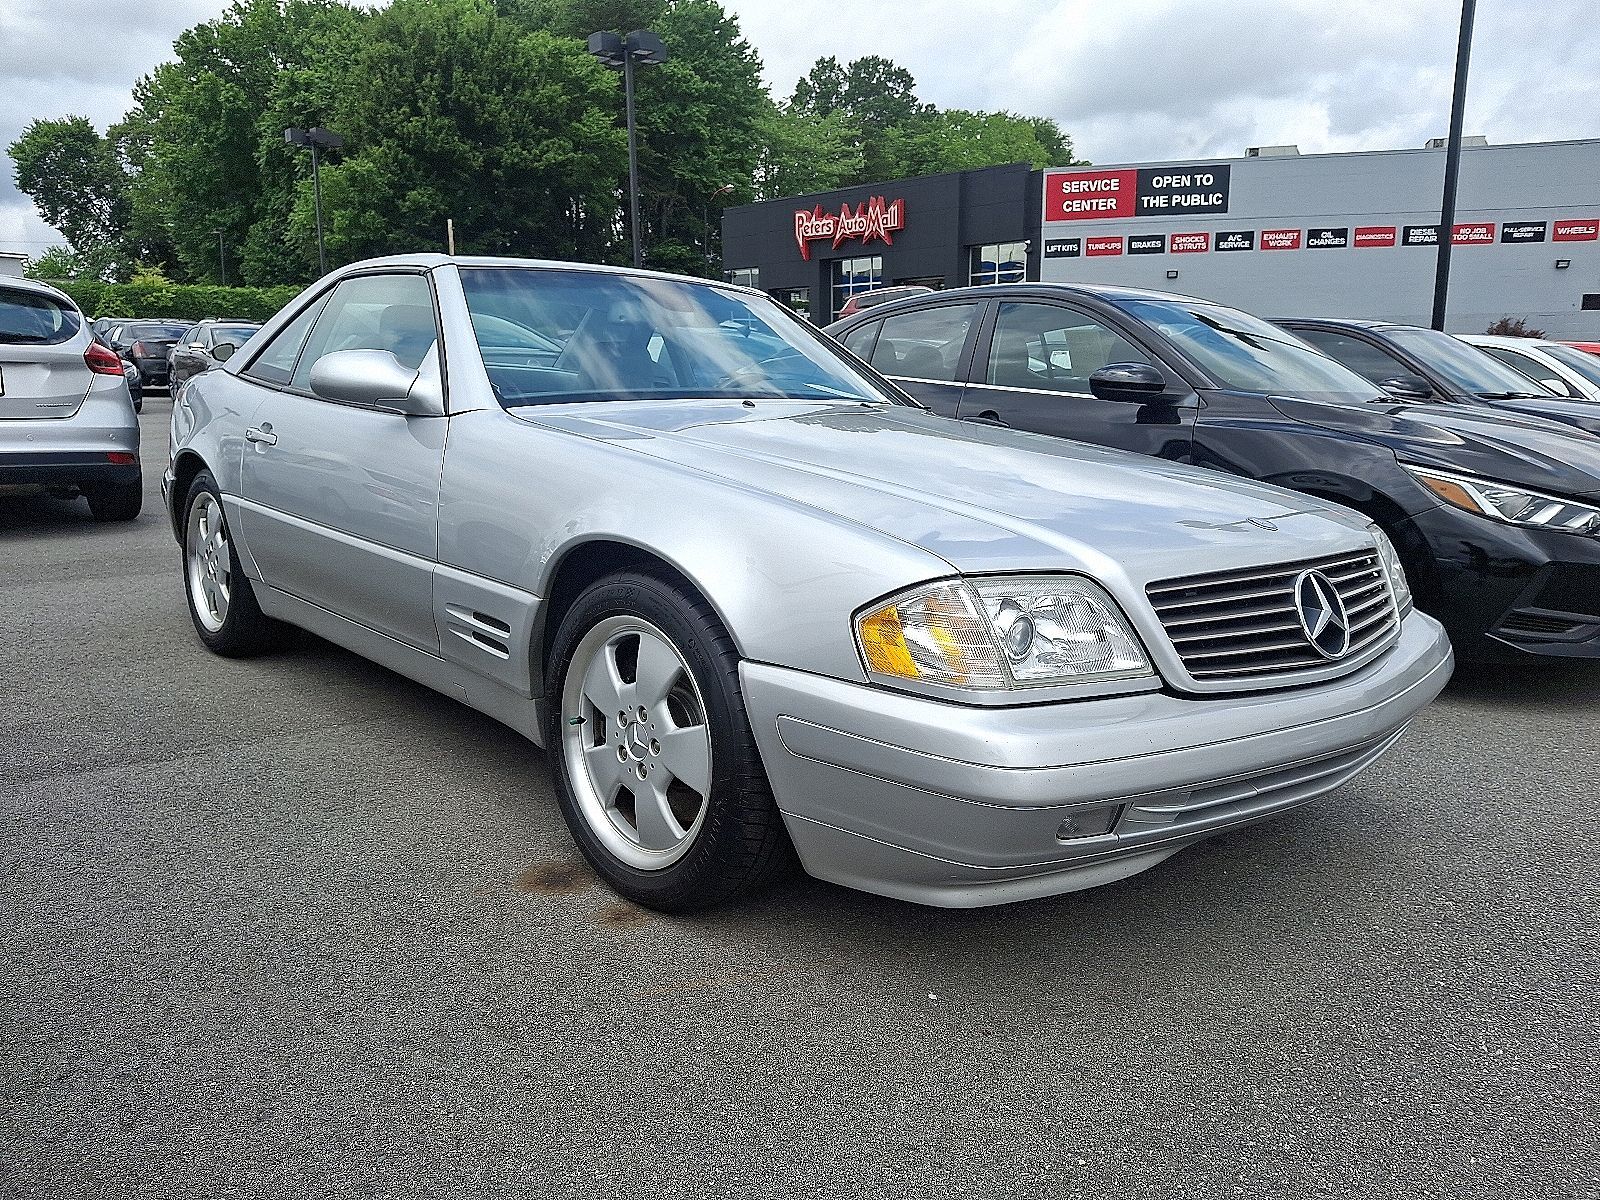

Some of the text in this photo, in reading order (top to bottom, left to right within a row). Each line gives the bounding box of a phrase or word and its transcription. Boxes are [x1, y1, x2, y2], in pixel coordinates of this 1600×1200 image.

[1152, 173, 1214, 189] OPEN TO
[1062, 178, 1120, 194] SERVICE
[1141, 192, 1223, 208] THE PUBLIC
[1062, 198, 1117, 212] CENTER
[795, 200, 900, 252] Peters Auto Mall
[1409, 227, 1437, 235] DIESEL
[1557, 226, 1596, 235] WHEELS
[1174, 235, 1205, 243] SHOCKS
[1227, 234, 1242, 242] A/C
[1263, 232, 1298, 240] EXHAUST
[1321, 231, 1333, 239] OIL
[1408, 235, 1437, 243] REPAIR
[1131, 240, 1162, 249] BRAKES
[1219, 240, 1250, 248] SERVICE
[1268, 239, 1292, 247] WORK
[1308, 237, 1346, 246] CHANGES
[1046, 243, 1078, 252] LIFT KITS
[1087, 242, 1121, 250] TUNE-UPS
[1179, 242, 1206, 250] STRUTS
